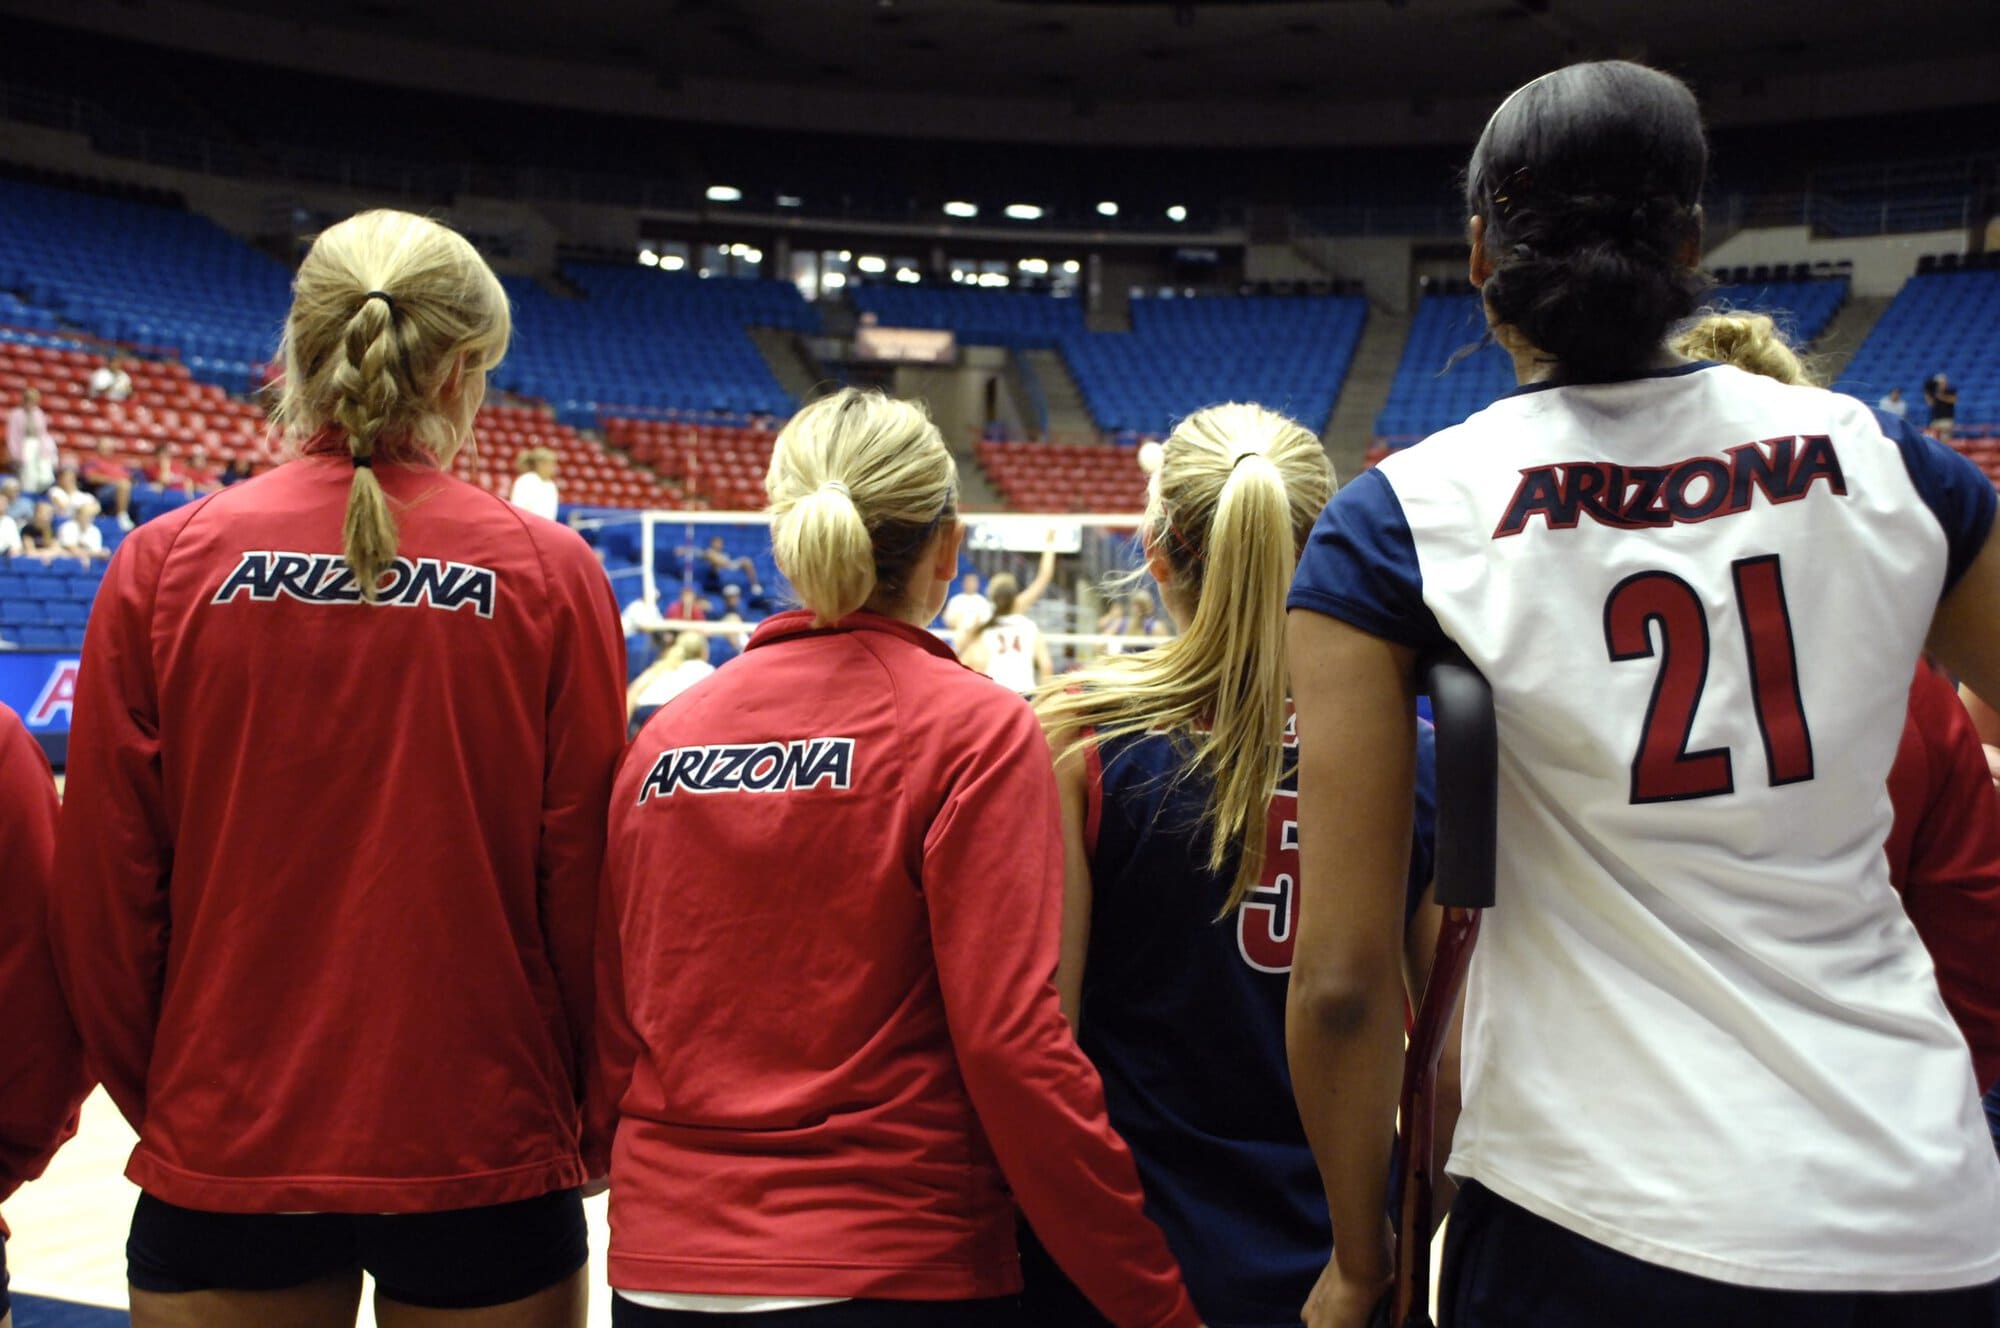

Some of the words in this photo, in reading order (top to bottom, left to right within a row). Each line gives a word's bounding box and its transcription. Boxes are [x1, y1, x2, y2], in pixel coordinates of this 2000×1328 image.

[1492, 434, 1848, 539] ARIZONA
[210, 551, 497, 619] ARIZONA
[1603, 553, 1814, 804] 21
[636, 736, 856, 806] ARIZONA
